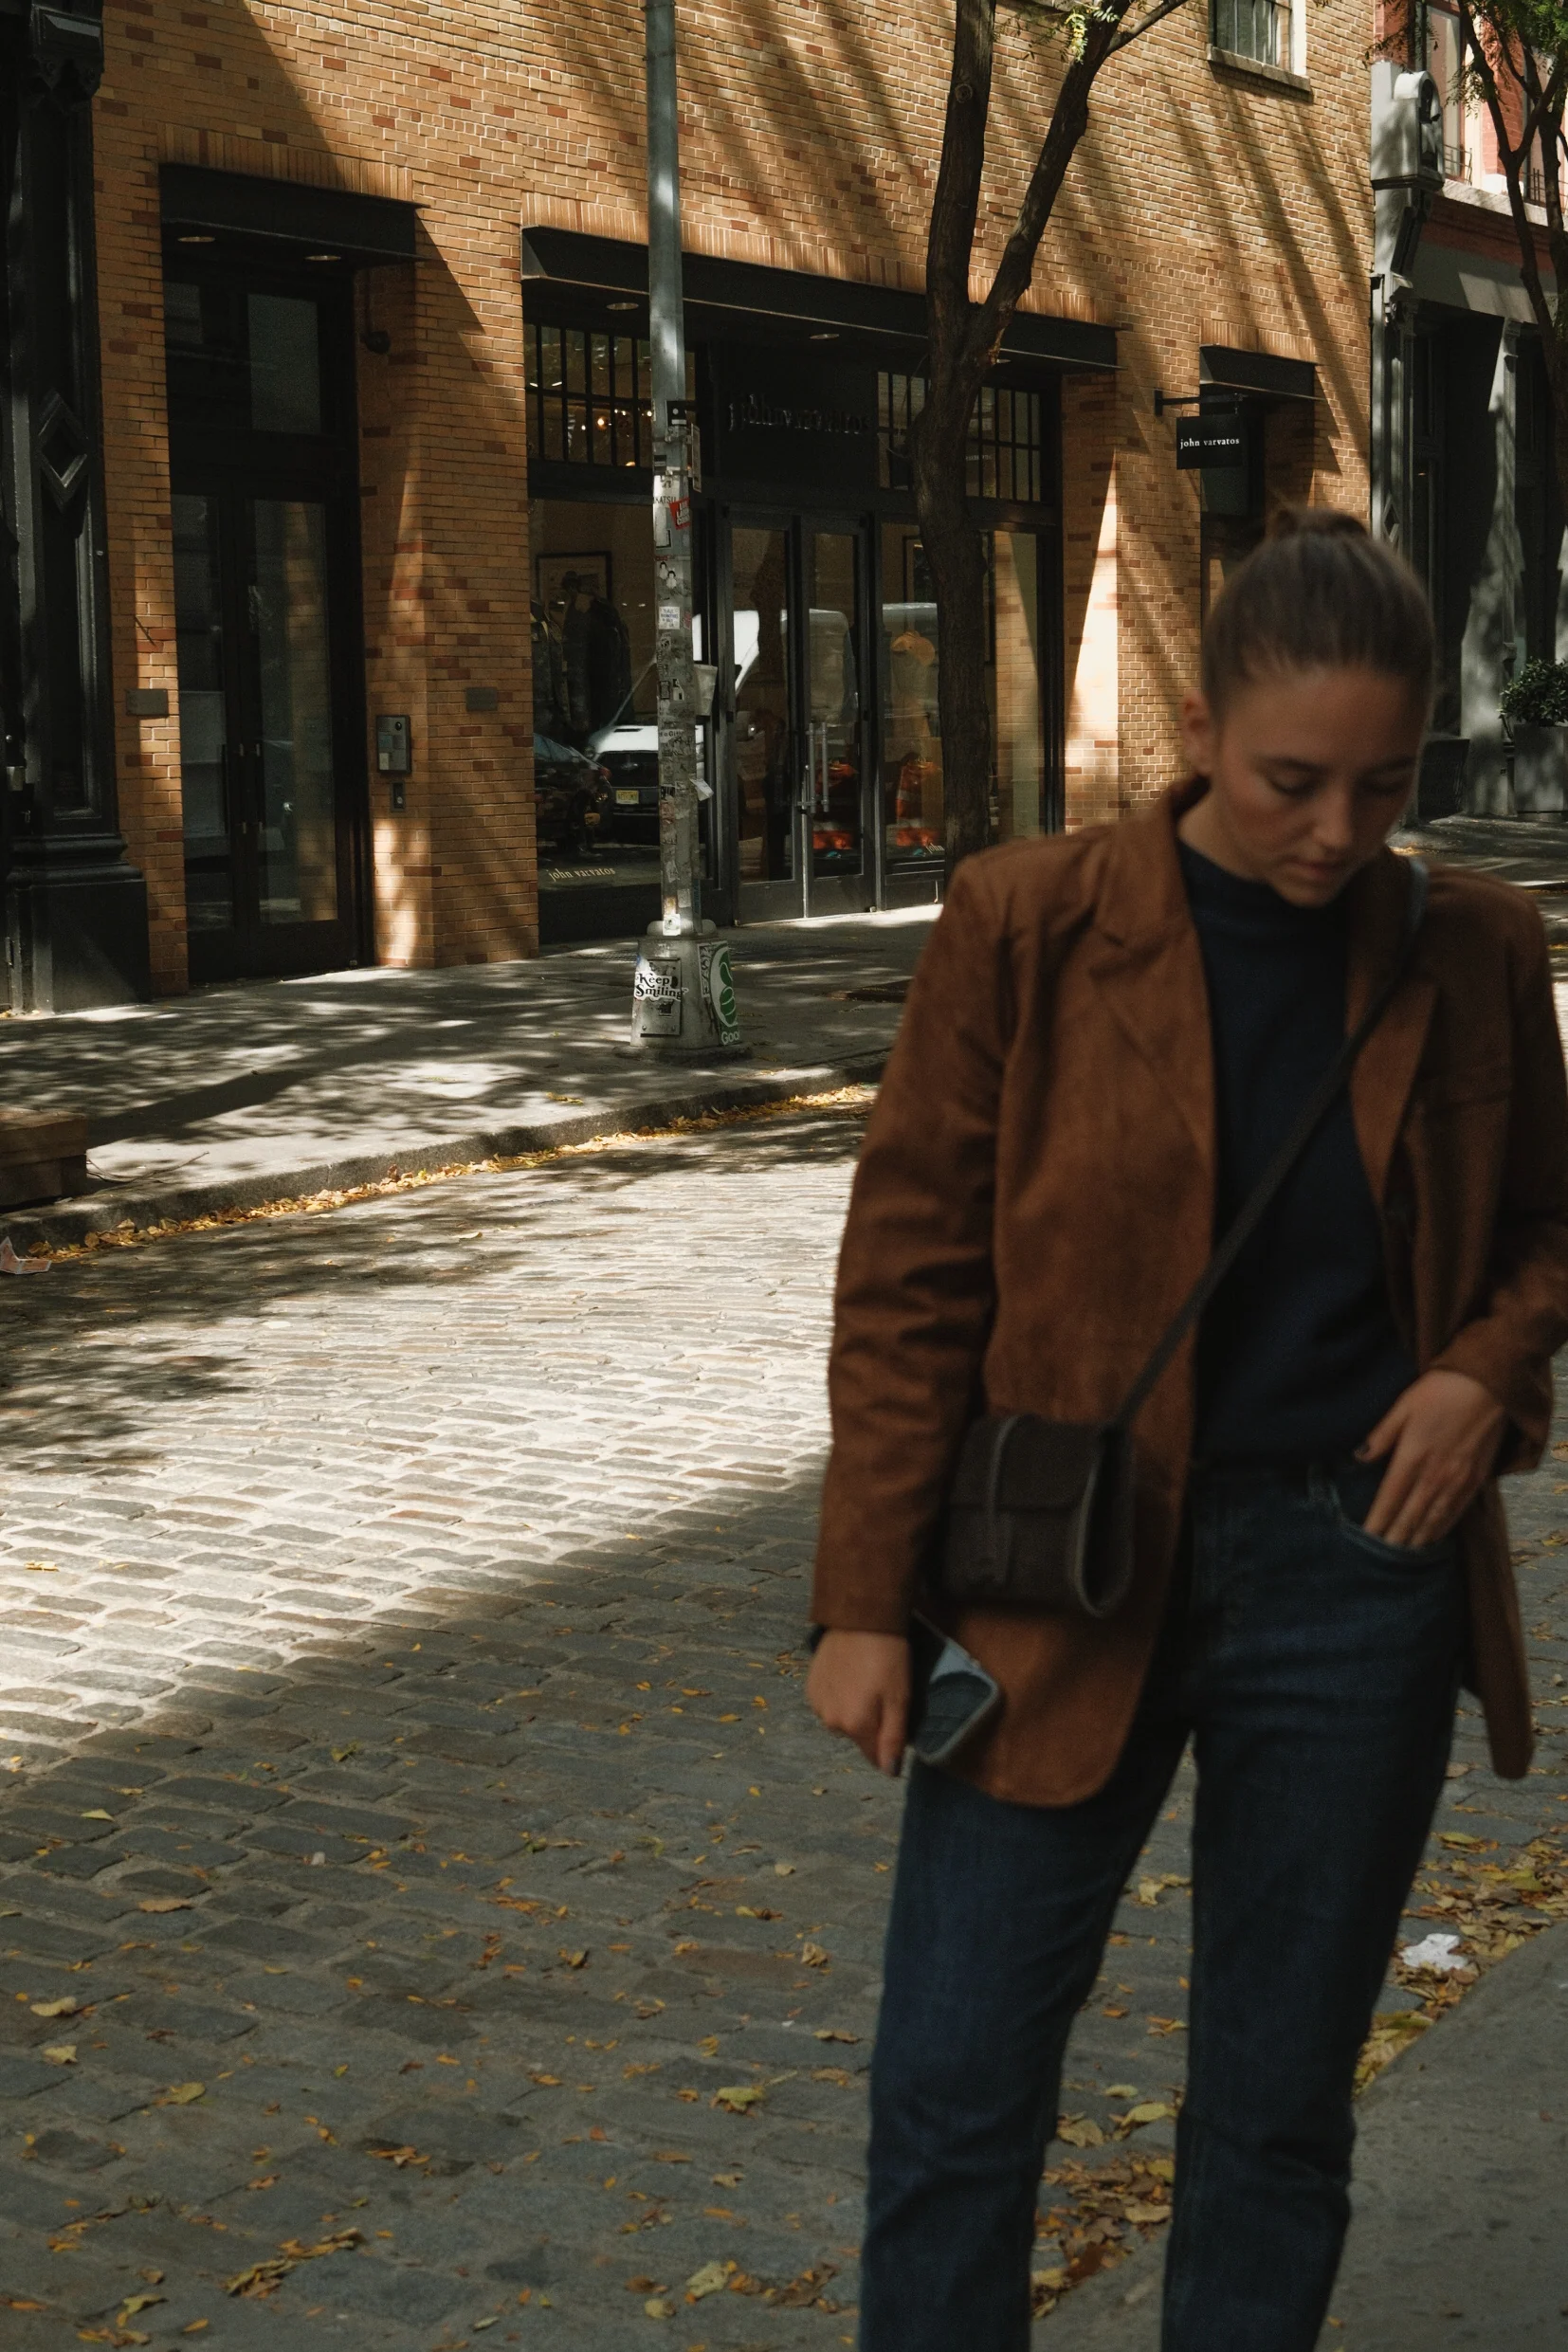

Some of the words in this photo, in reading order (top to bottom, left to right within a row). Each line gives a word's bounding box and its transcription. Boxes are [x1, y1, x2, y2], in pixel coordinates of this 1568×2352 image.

[1179, 437, 1200, 450] john
[1203, 437, 1240, 447] varvatos
[925, 842, 945, 854] john
[546, 868, 574, 883] john
[574, 867, 615, 877] varvatos
[636, 973, 669, 988] Keep
[636, 984, 685, 1000] Smiling
